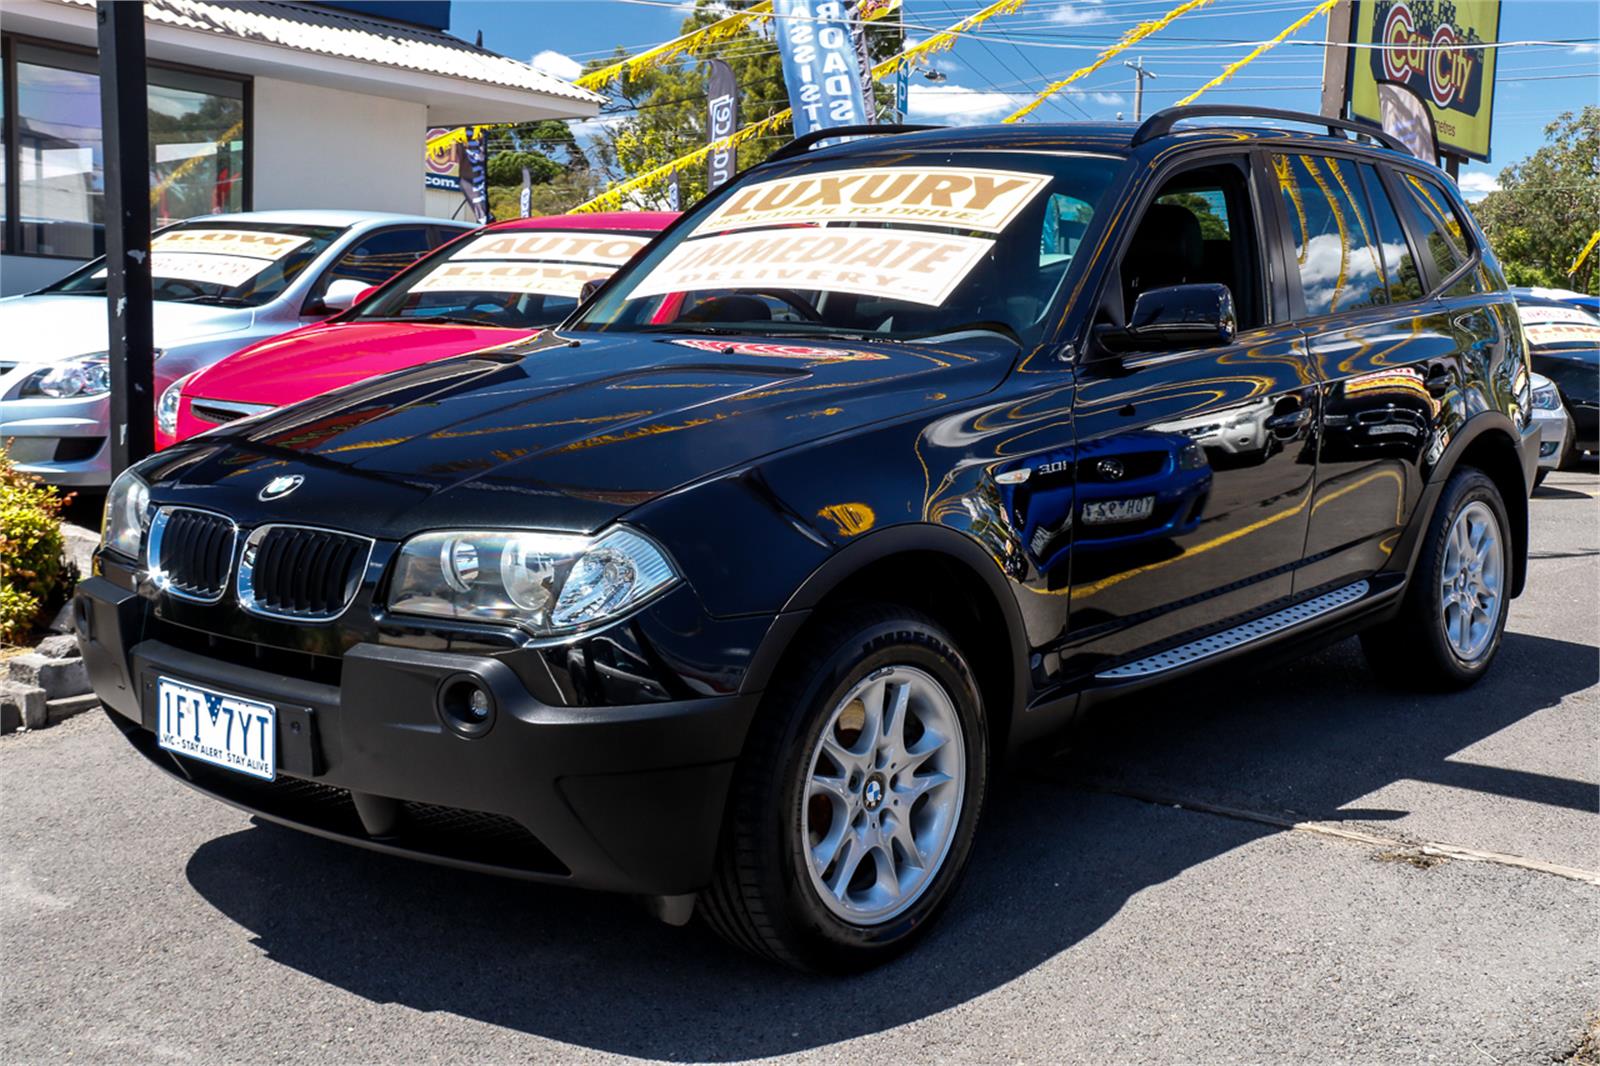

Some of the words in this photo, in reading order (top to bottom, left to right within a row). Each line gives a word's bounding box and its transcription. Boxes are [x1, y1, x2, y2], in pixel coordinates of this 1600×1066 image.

[1383, 5, 1426, 81] Car
[1429, 24, 1472, 106] City
[720, 174, 1027, 217] LUXURY
[707, 207, 837, 228] BEAUTIFUL
[848, 206, 883, 215] TO
[887, 207, 996, 221] DRIVE!
[167, 233, 296, 246] LOW
[472, 237, 645, 258] AUTO
[664, 235, 966, 275] IMMEDIATE
[165, 691, 201, 743] 1FI
[222, 706, 269, 761] 7YT
[181, 739, 199, 753] STAY
[200, 745, 223, 760] ALERT
[227, 752, 245, 767] STAY
[247, 758, 269, 774] ALIVE
